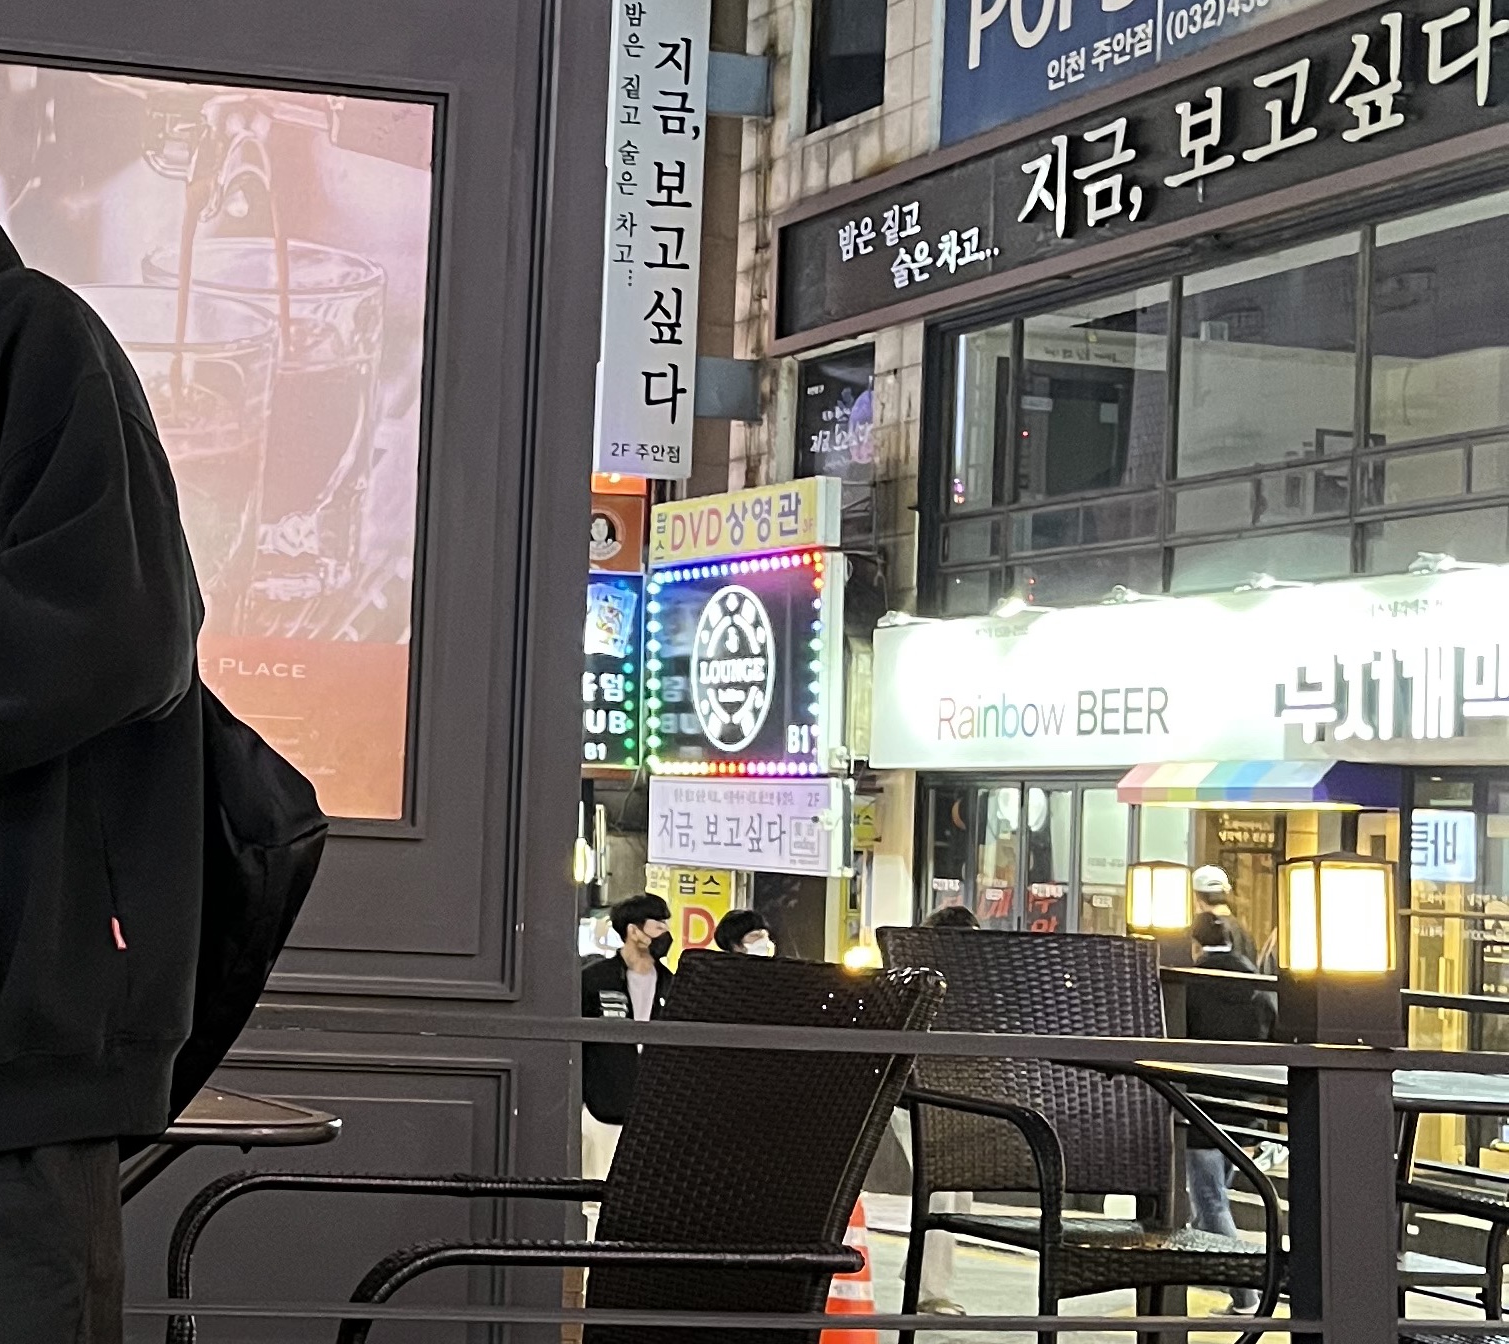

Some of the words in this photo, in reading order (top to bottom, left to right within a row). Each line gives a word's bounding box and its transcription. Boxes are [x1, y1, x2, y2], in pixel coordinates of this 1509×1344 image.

[622, 2, 647, 58] 밤은
[1046, 52, 1085, 91] 인천
[1091, 19, 1155, 72] 주안점
[616, 140, 641, 196] 술은
[838, 216, 877, 262] 밤은
[891, 241, 933, 289] 술은
[610, 442, 631, 458] 2F
[635, 443, 681, 465] 주안점
[699, 657, 766, 685] LOUNGE
[937, 692, 1066, 741] Rainbow
[1076, 686, 1170, 737] BEER
[787, 724, 810, 755] B1
[806, 792, 820, 807] 2F
[703, 812, 787, 856] 보고싶다
[678, 873, 721, 895] 팝스
